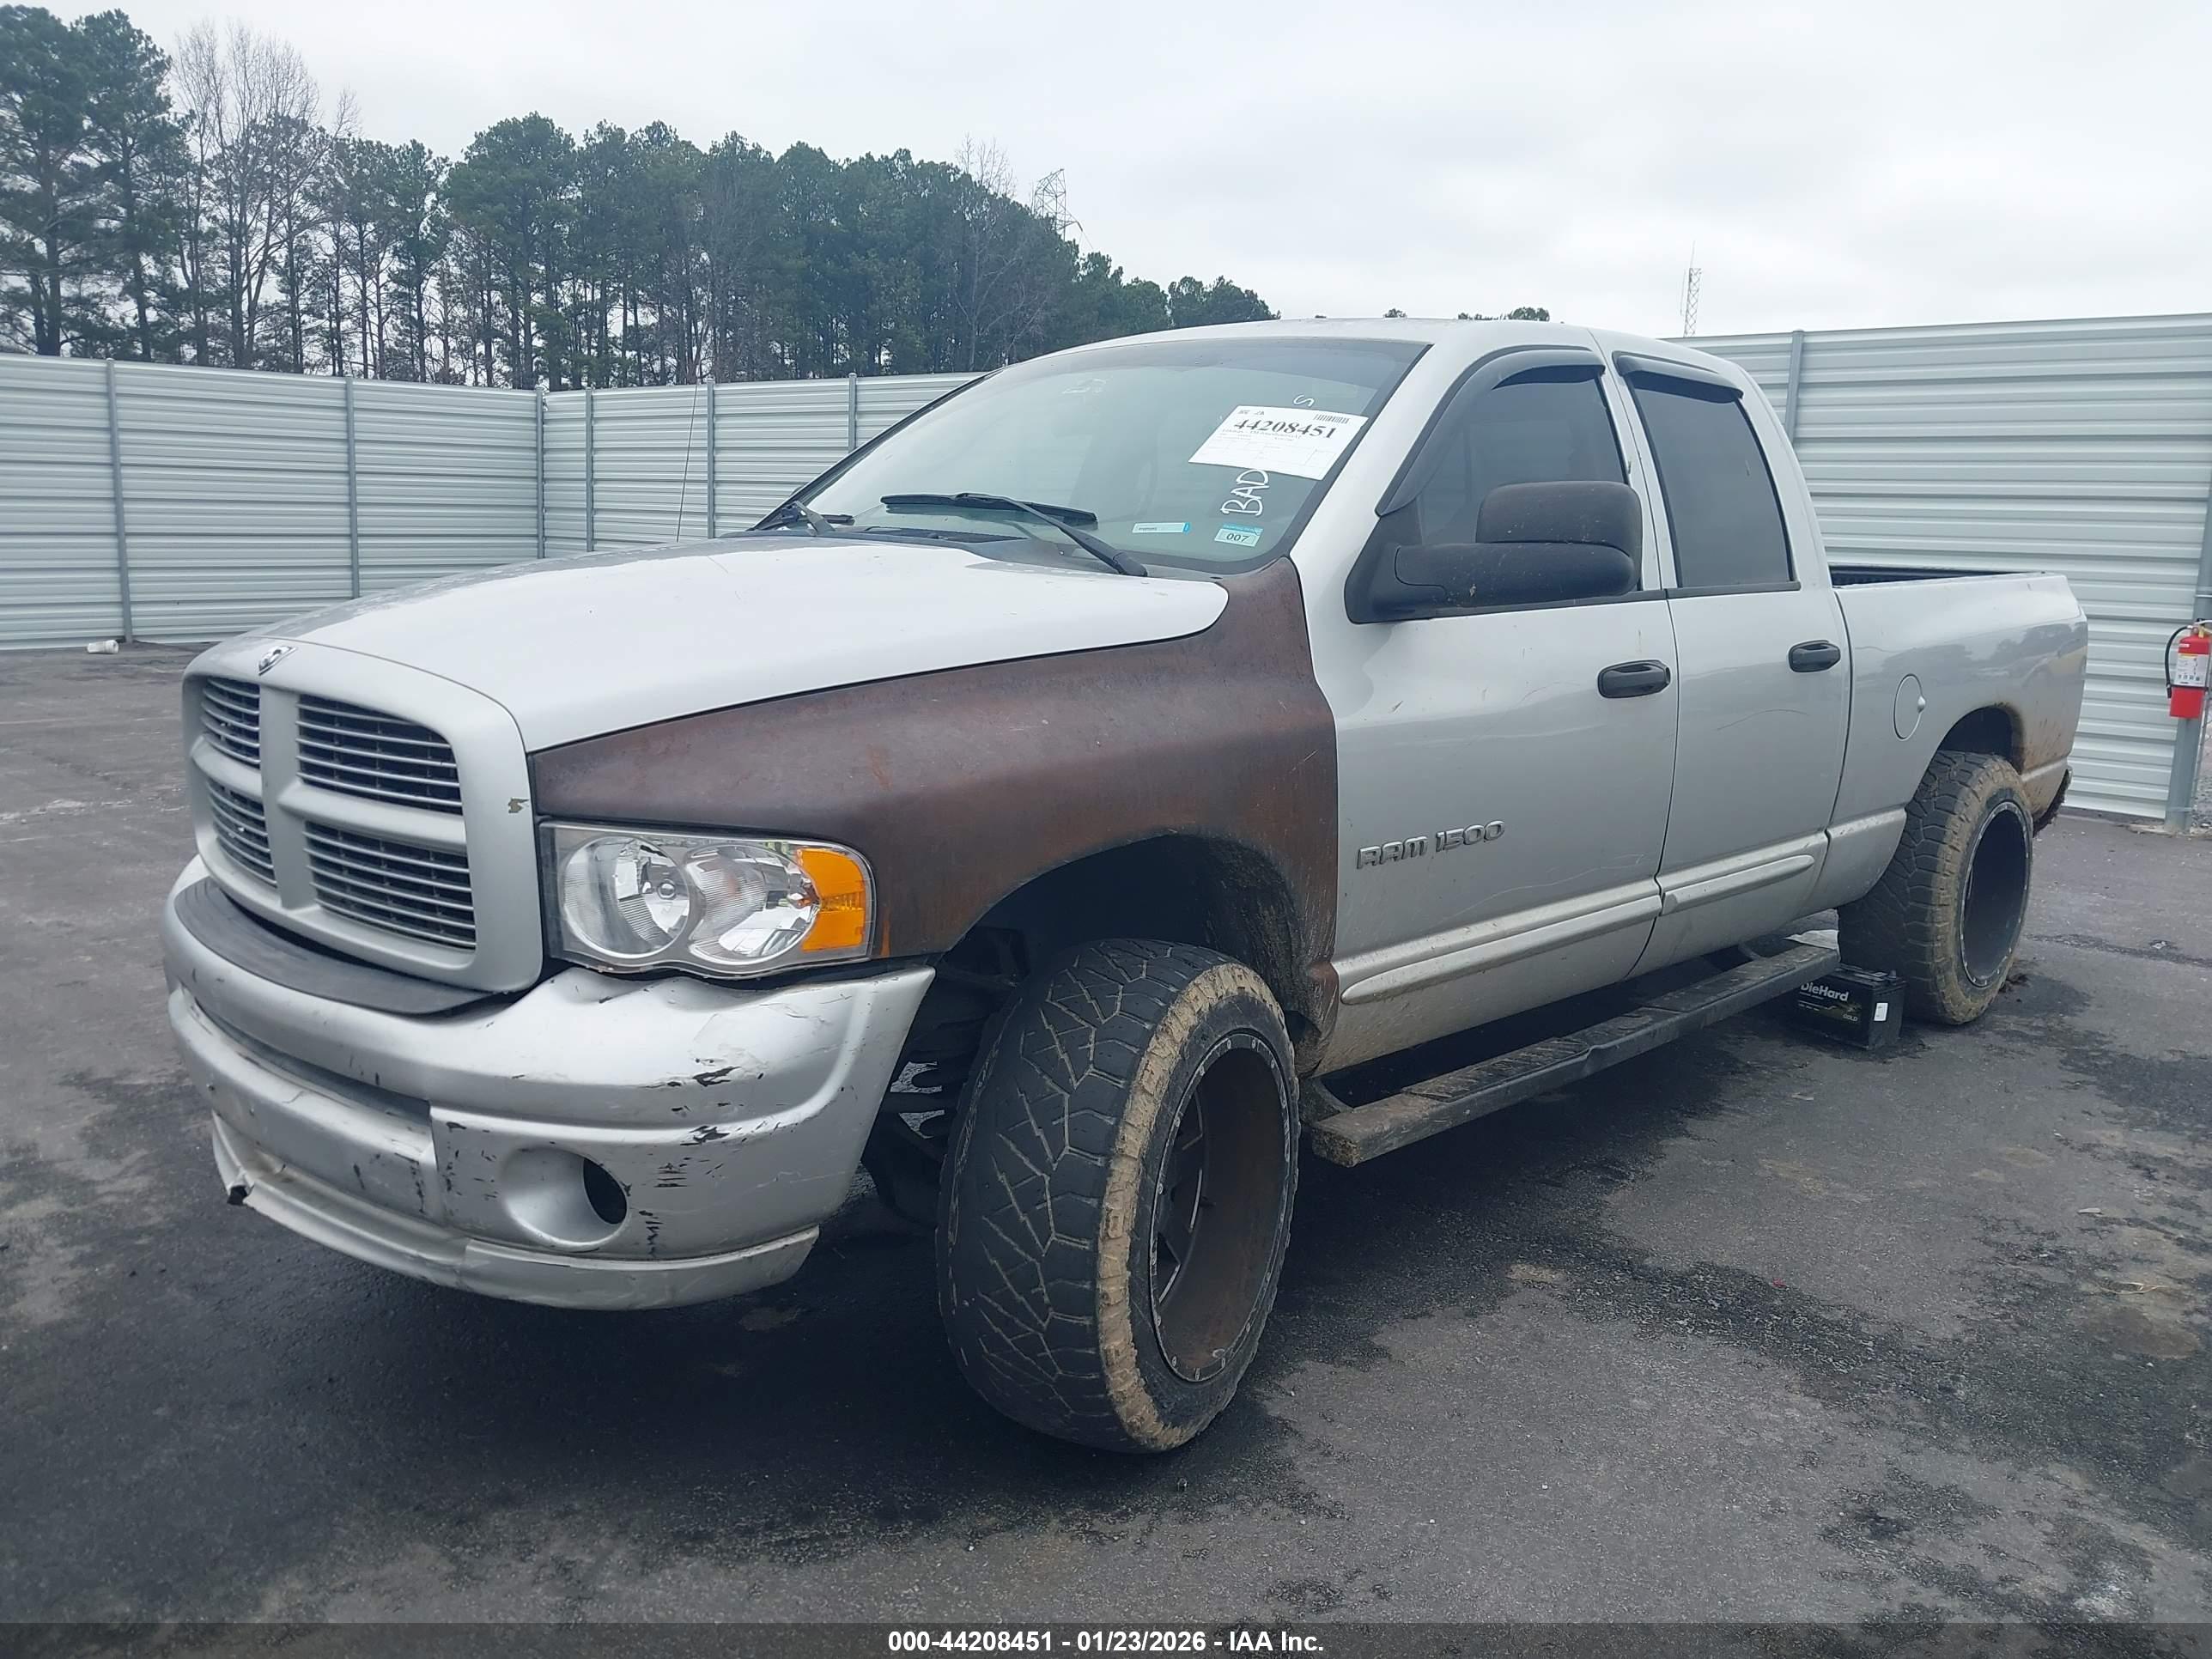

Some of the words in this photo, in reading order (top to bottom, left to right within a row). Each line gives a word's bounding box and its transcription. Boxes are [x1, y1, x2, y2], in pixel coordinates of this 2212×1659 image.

[1234, 419, 1337, 439] 44208451
[1219, 469, 1270, 516] BAD
[1226, 532, 1249, 543] 007
[1356, 836, 1429, 870] RAM
[1435, 820, 1505, 853] 1500
[1843, 1013, 1859, 1022] GOLD
